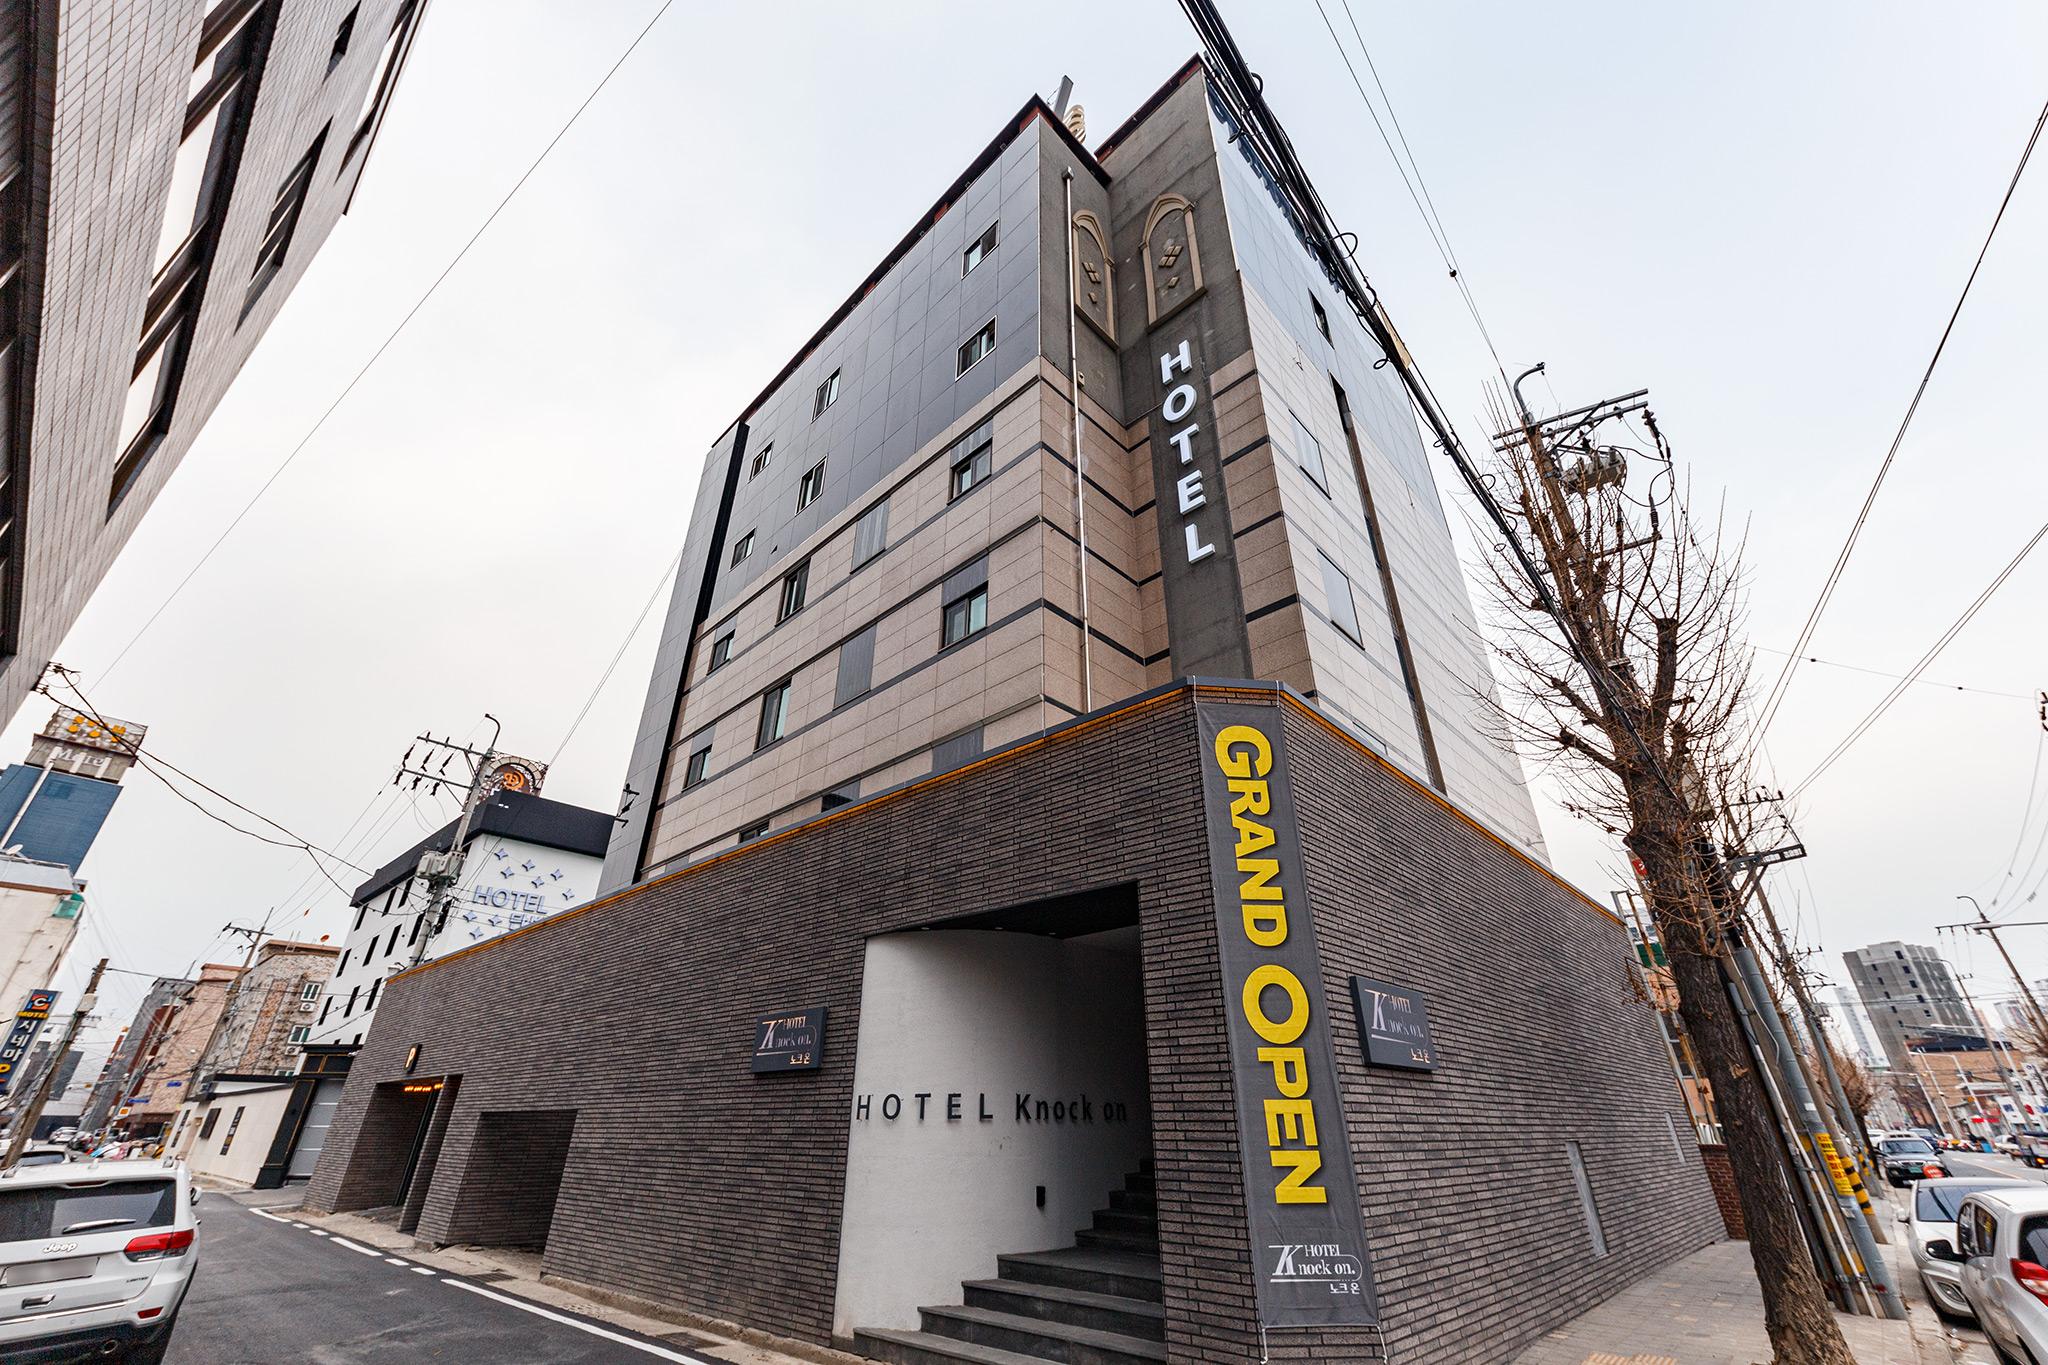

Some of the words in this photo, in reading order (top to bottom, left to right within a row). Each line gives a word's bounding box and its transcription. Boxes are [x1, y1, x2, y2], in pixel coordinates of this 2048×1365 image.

[1160, 339, 1216, 564] HOTEL
[1214, 725, 1289, 948] GRAND
[472, 885, 548, 914] HOTEL
[783, 1016, 807, 1030] HOTEL
[2, 1020, 38, 1062] 시네마
[405, 1047, 415, 1067] P
[1242, 964, 1328, 1204] OPEN
[855, 1093, 994, 1122] HOTEL
[1014, 1093, 1094, 1122] Knock
[1103, 1101, 1128, 1122] on
[43, 1242, 78, 1254] Jeep
[1304, 1244, 1340, 1257] HOTEL
